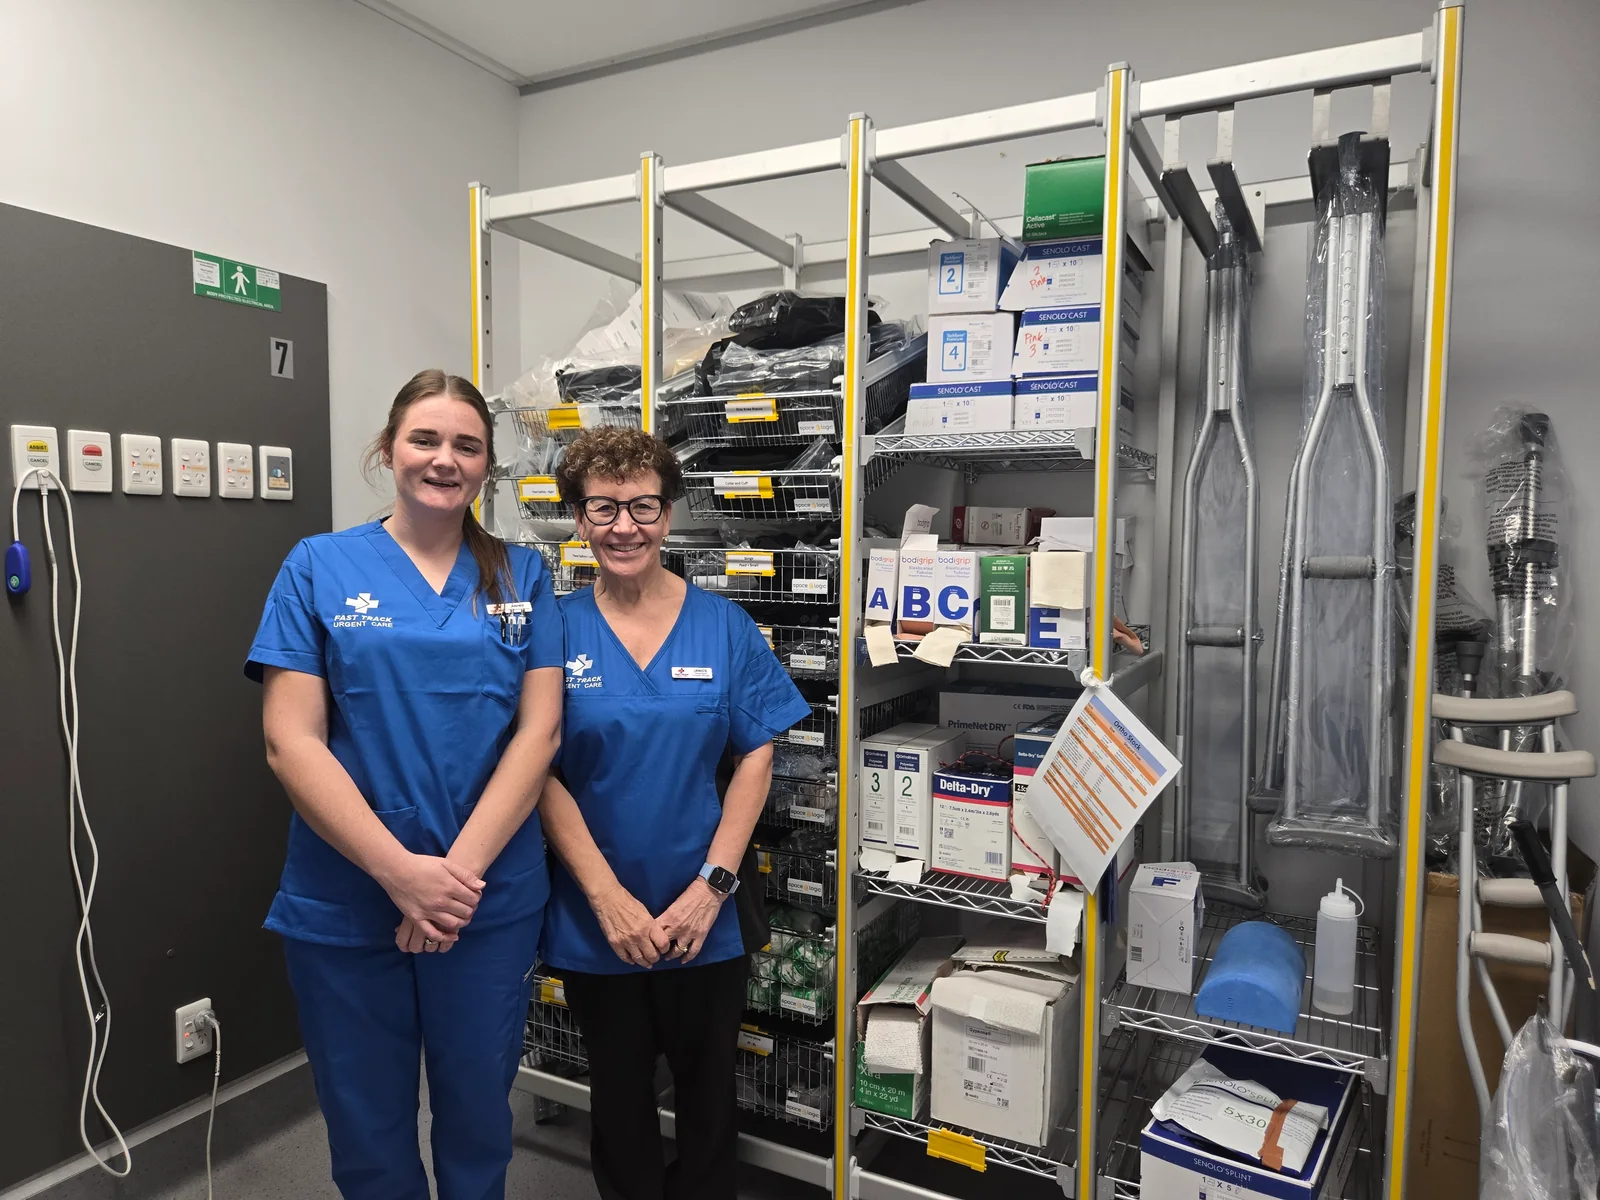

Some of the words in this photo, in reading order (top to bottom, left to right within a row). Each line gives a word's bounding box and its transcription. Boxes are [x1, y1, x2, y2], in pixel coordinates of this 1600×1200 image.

[946, 268, 955, 283] 2
[1034, 265, 1040, 276] 2
[1030, 275, 1046, 290] Pink
[1024, 332, 1043, 344] Pink
[276, 341, 288, 374] 7
[949, 346, 959, 360] 4
[1029, 344, 1036, 358] 3
[902, 557, 933, 565] bodigrip
[938, 557, 970, 565] bodigrip
[868, 587, 889, 610] A
[902, 586, 930, 618] B
[938, 586, 969, 620] C
[361, 615, 392, 623] TRACK
[1030, 608, 1060, 649] E
[948, 720, 989, 730] PrimeNet
[1114, 720, 1128, 737] Ortho
[1127, 735, 1142, 751] Stock
[871, 772, 880, 792] 3
[902, 776, 912, 797] 2
[811, 811, 824, 819] logic
[1152, 876, 1180, 886] F
[1250, 1090, 1280, 1106] SPLIN
[1224, 1106, 1267, 1129] 5x30
